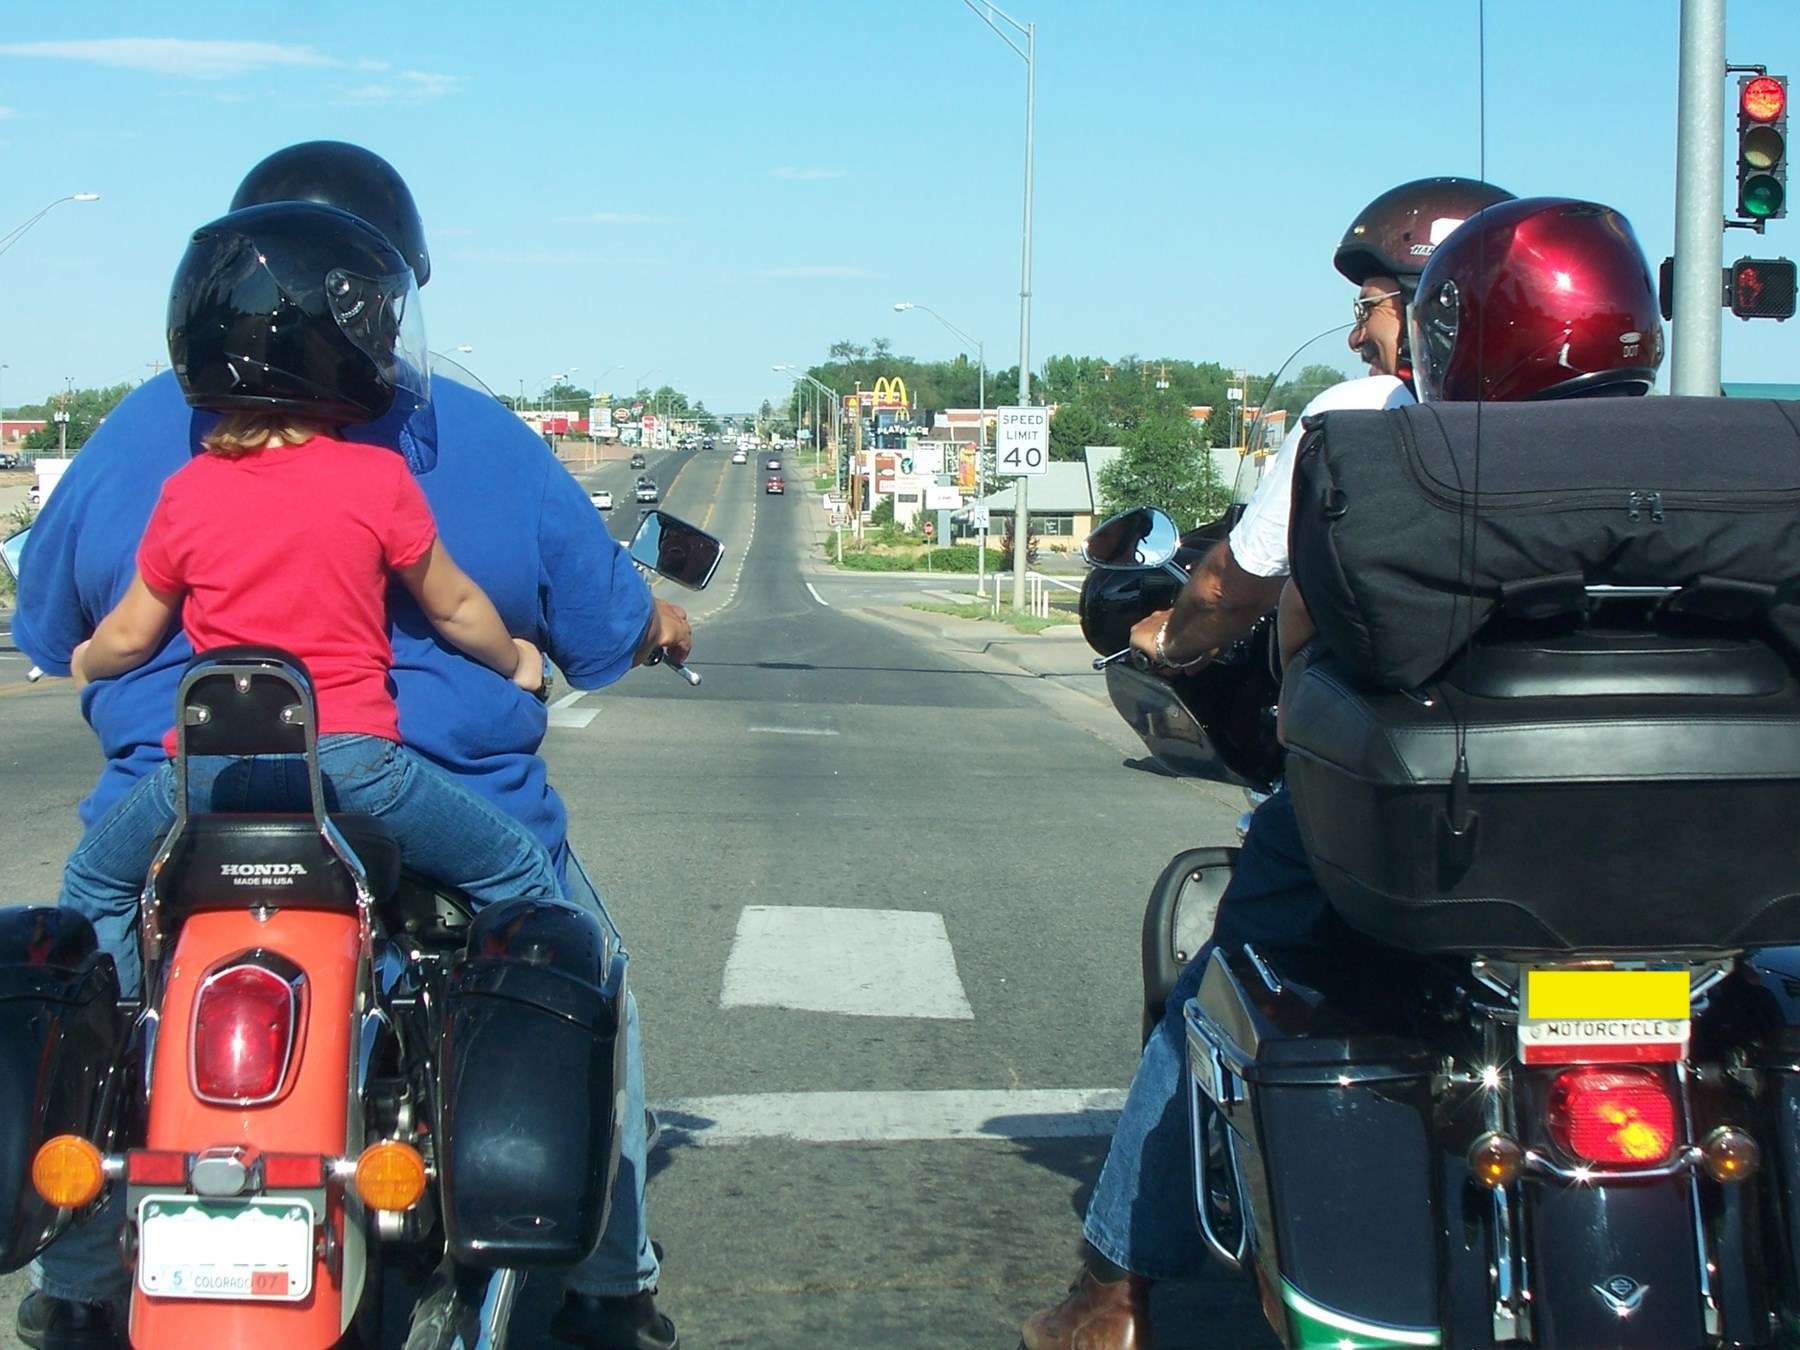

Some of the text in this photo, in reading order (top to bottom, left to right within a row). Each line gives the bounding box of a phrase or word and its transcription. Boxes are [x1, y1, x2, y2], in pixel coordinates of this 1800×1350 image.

[1003, 415, 1044, 425] SPEED
[877, 424, 929, 436] PLAYPLACE
[1006, 430, 1039, 441] LIMIT
[1003, 447, 1042, 468] 40
[220, 863, 308, 876] HONDA
[233, 877, 294, 886] MADE IN USA
[1547, 1021, 1663, 1037] MOTORCYCLE
